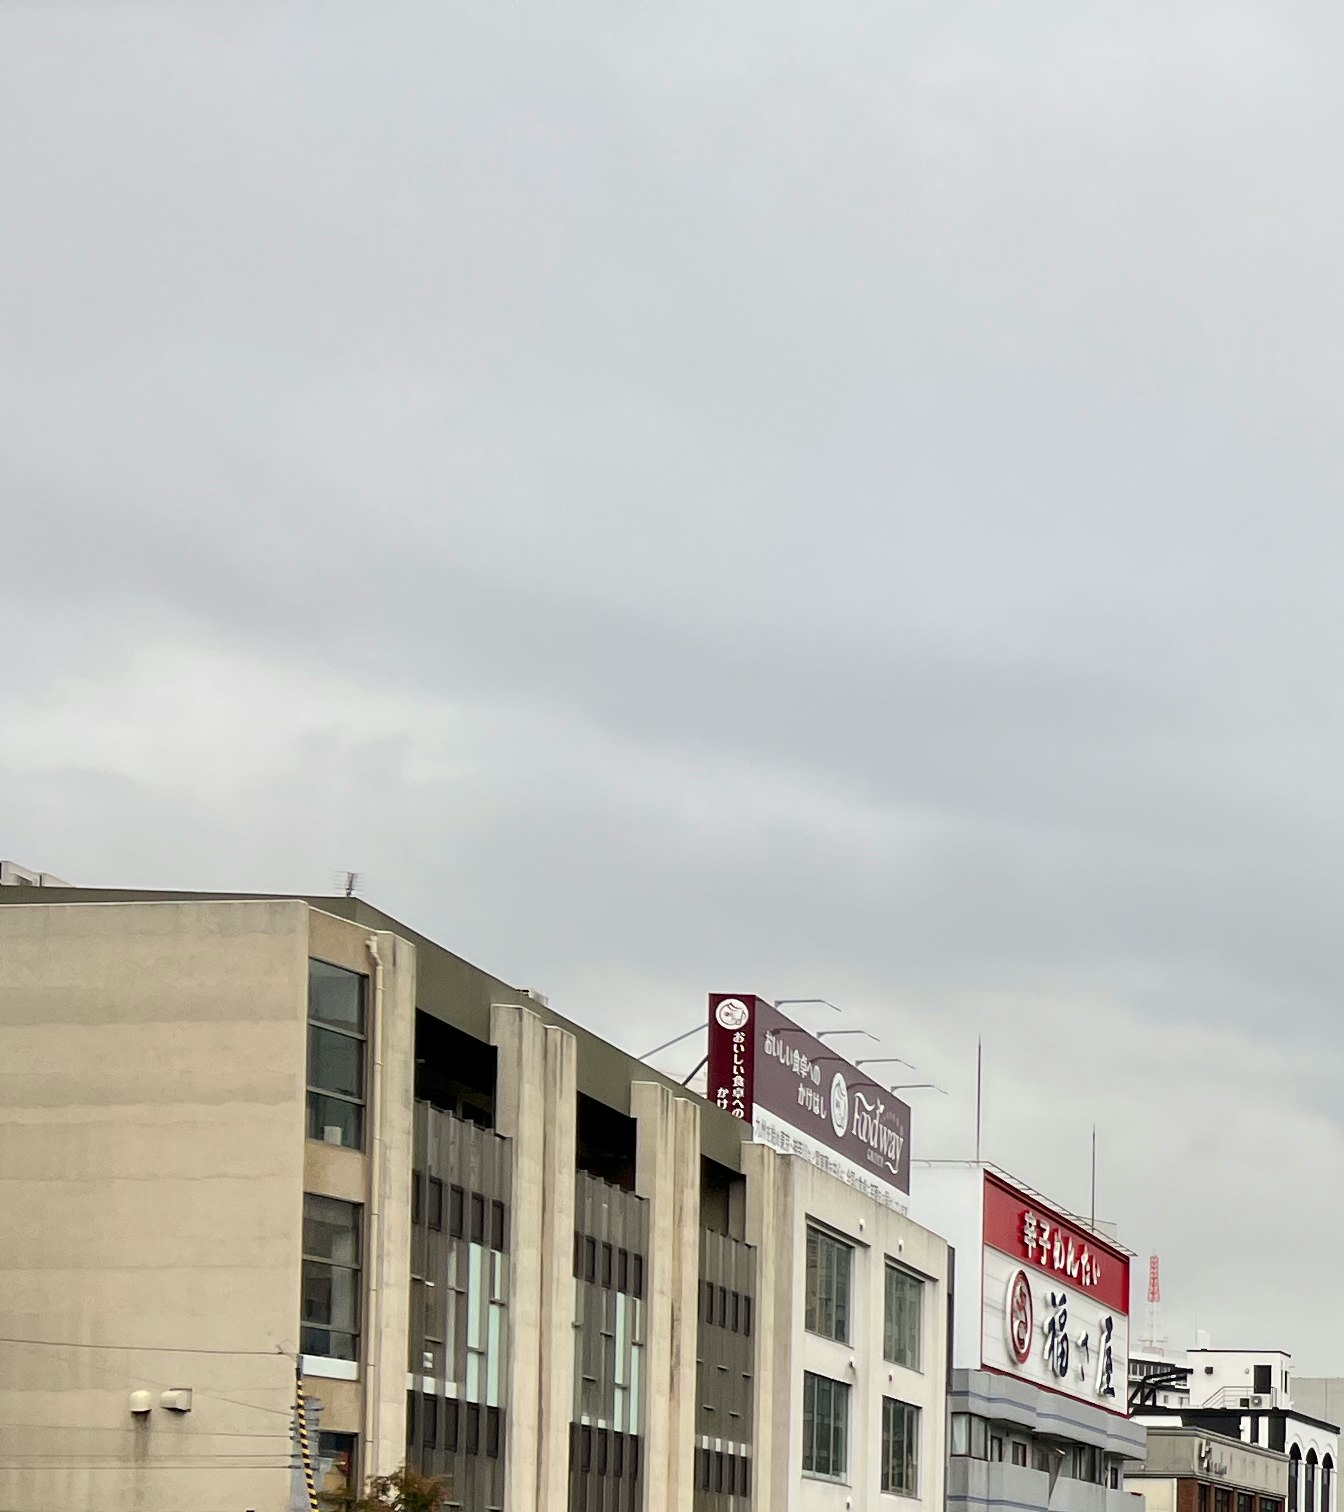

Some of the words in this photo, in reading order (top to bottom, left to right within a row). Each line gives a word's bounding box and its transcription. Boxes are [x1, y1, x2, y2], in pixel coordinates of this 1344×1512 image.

[731, 1032, 745, 1119] おいしい食卓への
[764, 1031, 821, 1086] おいしい食卓への
[717, 1087, 729, 1110] かけ
[797, 1083, 827, 1120] かけはし
[851, 1092, 904, 1174] Foodway
[1023, 1210, 1101, 1286] 辛子めんたい
